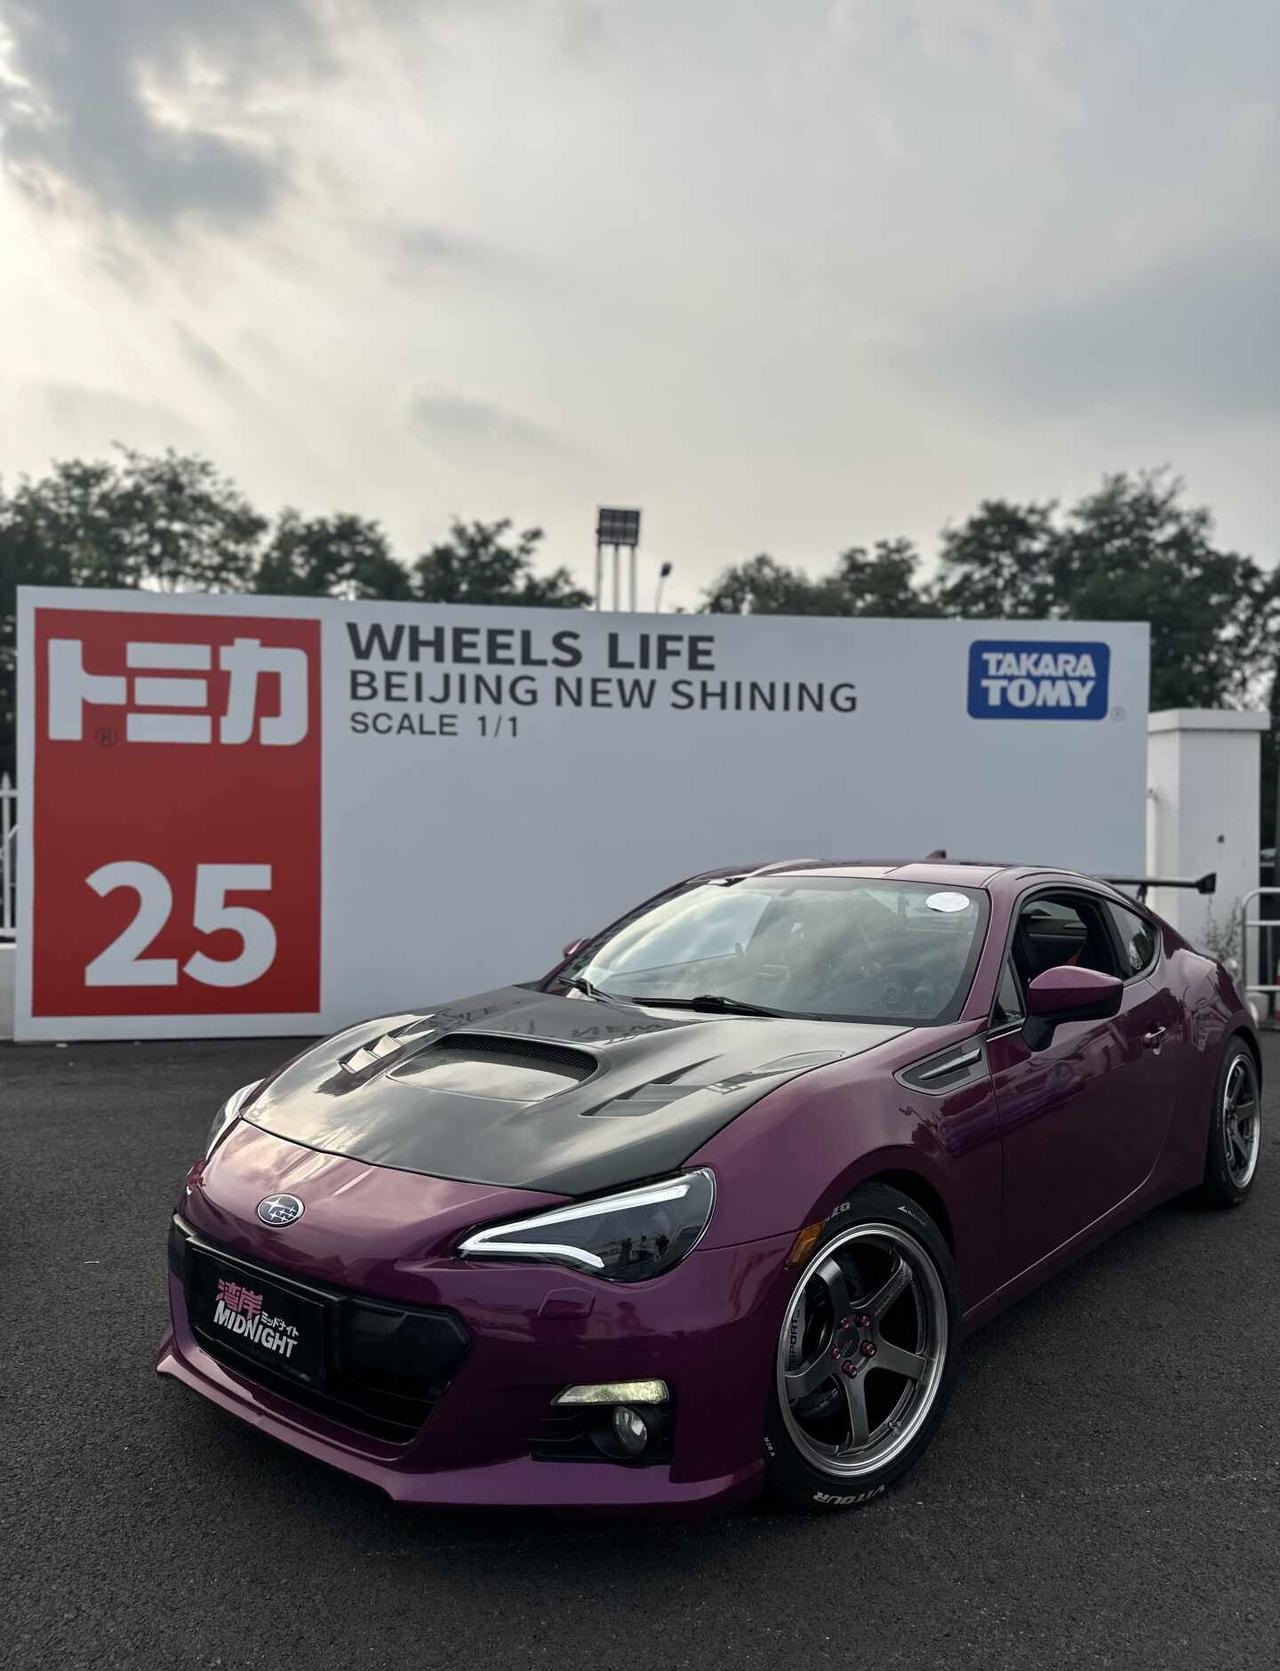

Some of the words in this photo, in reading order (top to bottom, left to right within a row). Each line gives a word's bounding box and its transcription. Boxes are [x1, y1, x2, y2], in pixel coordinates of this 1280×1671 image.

[346, 621, 583, 668] WHEELS
[608, 632, 715, 671] LIFE
[982, 652, 1096, 677] TAKARA
[48, 637, 309, 747] トミカ
[349, 670, 538, 706] BEIJING
[555, 677, 657, 709] NEW
[671, 680, 858, 713] SHINING
[981, 678, 1096, 708] TOMY
[350, 711, 458, 736] SCALE
[477, 714, 520, 739] 1/1
[84, 860, 278, 988] 25
[215, 1278, 263, 1320] 湾岸
[213, 1299, 298, 1358] MIDNIGHT
[812, 1484, 885, 1505] VITOUR
